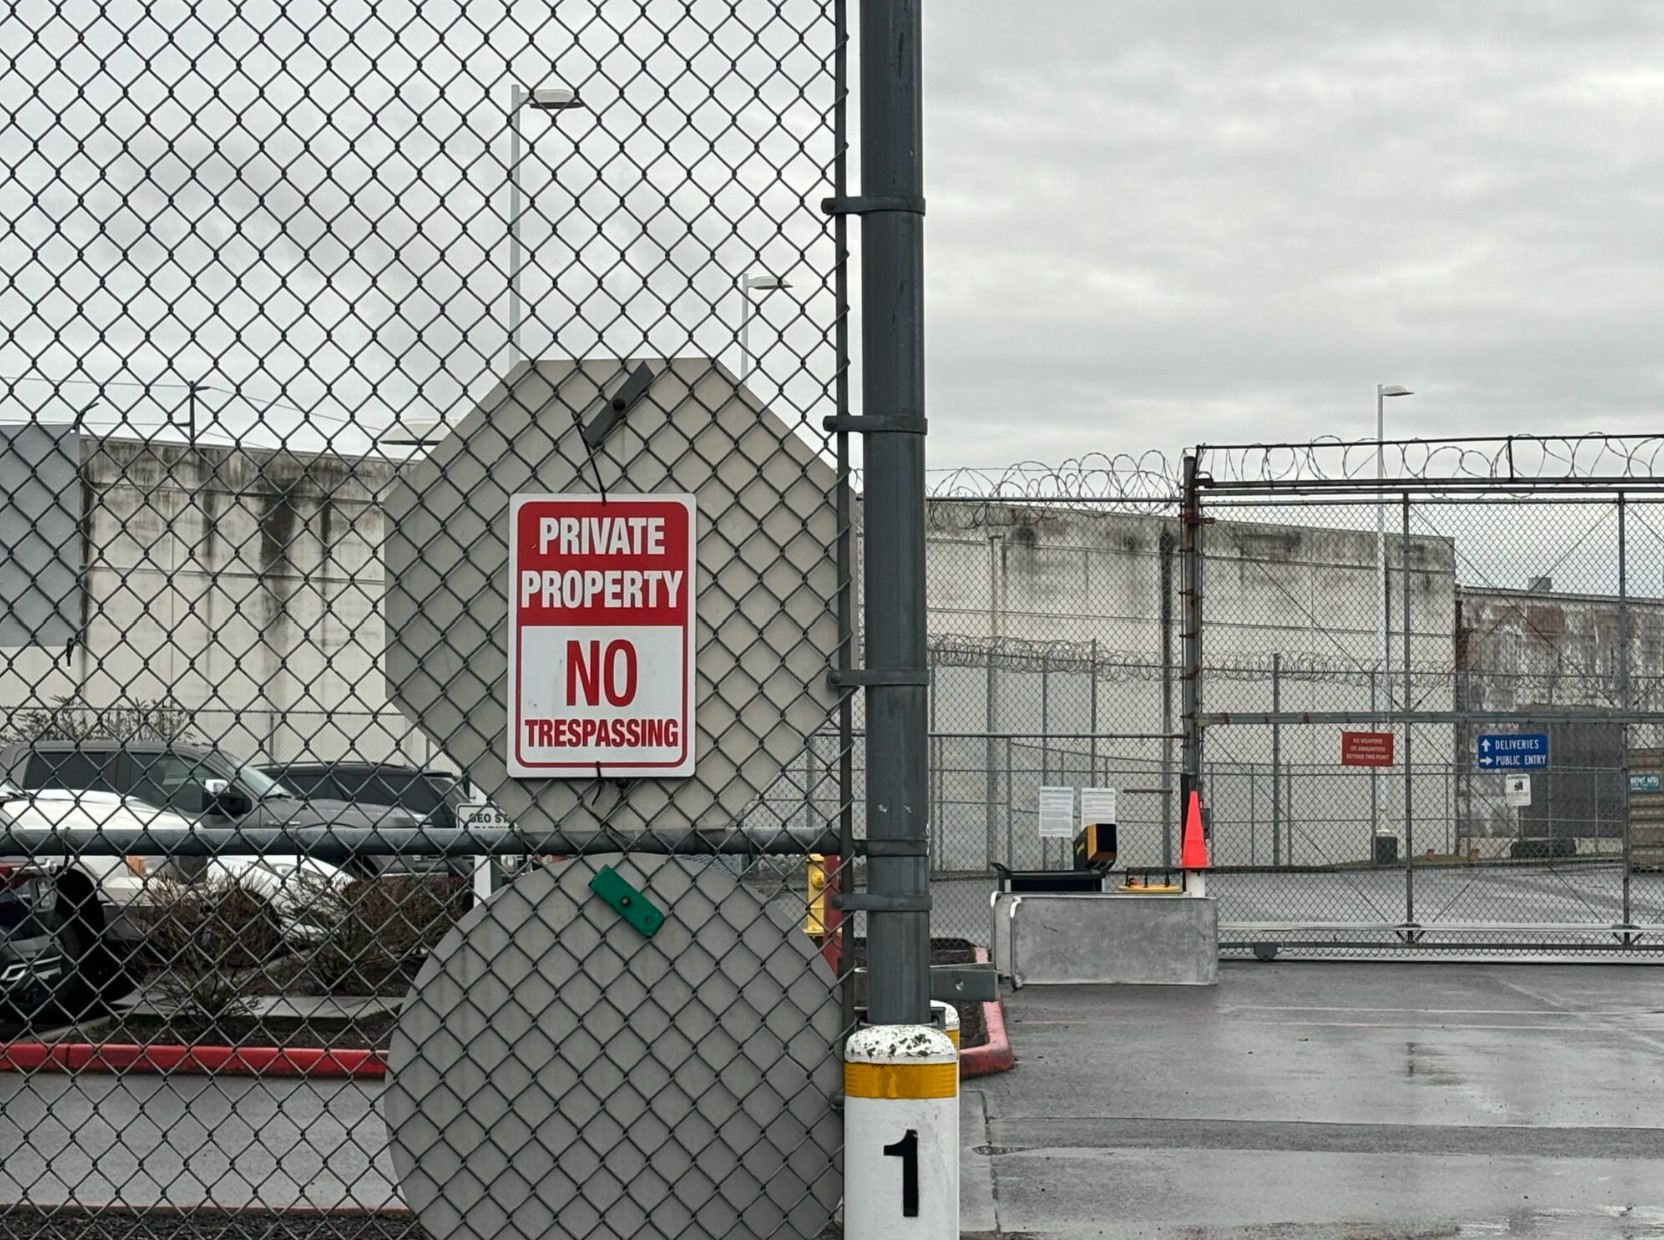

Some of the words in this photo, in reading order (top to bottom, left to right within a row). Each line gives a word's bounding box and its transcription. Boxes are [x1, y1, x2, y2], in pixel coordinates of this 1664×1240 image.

[539, 517, 665, 555] PRIVATE
[521, 570, 683, 609] PROPERTY
[566, 639, 638, 707] NO
[525, 719, 679, 748] TRESPASSING
[1495, 739, 1539, 750] DELIVERIES
[1495, 755, 1520, 766] PUBLIC
[1524, 754, 1547, 765] ENTRY
[884, 1129, 918, 1217] 1
